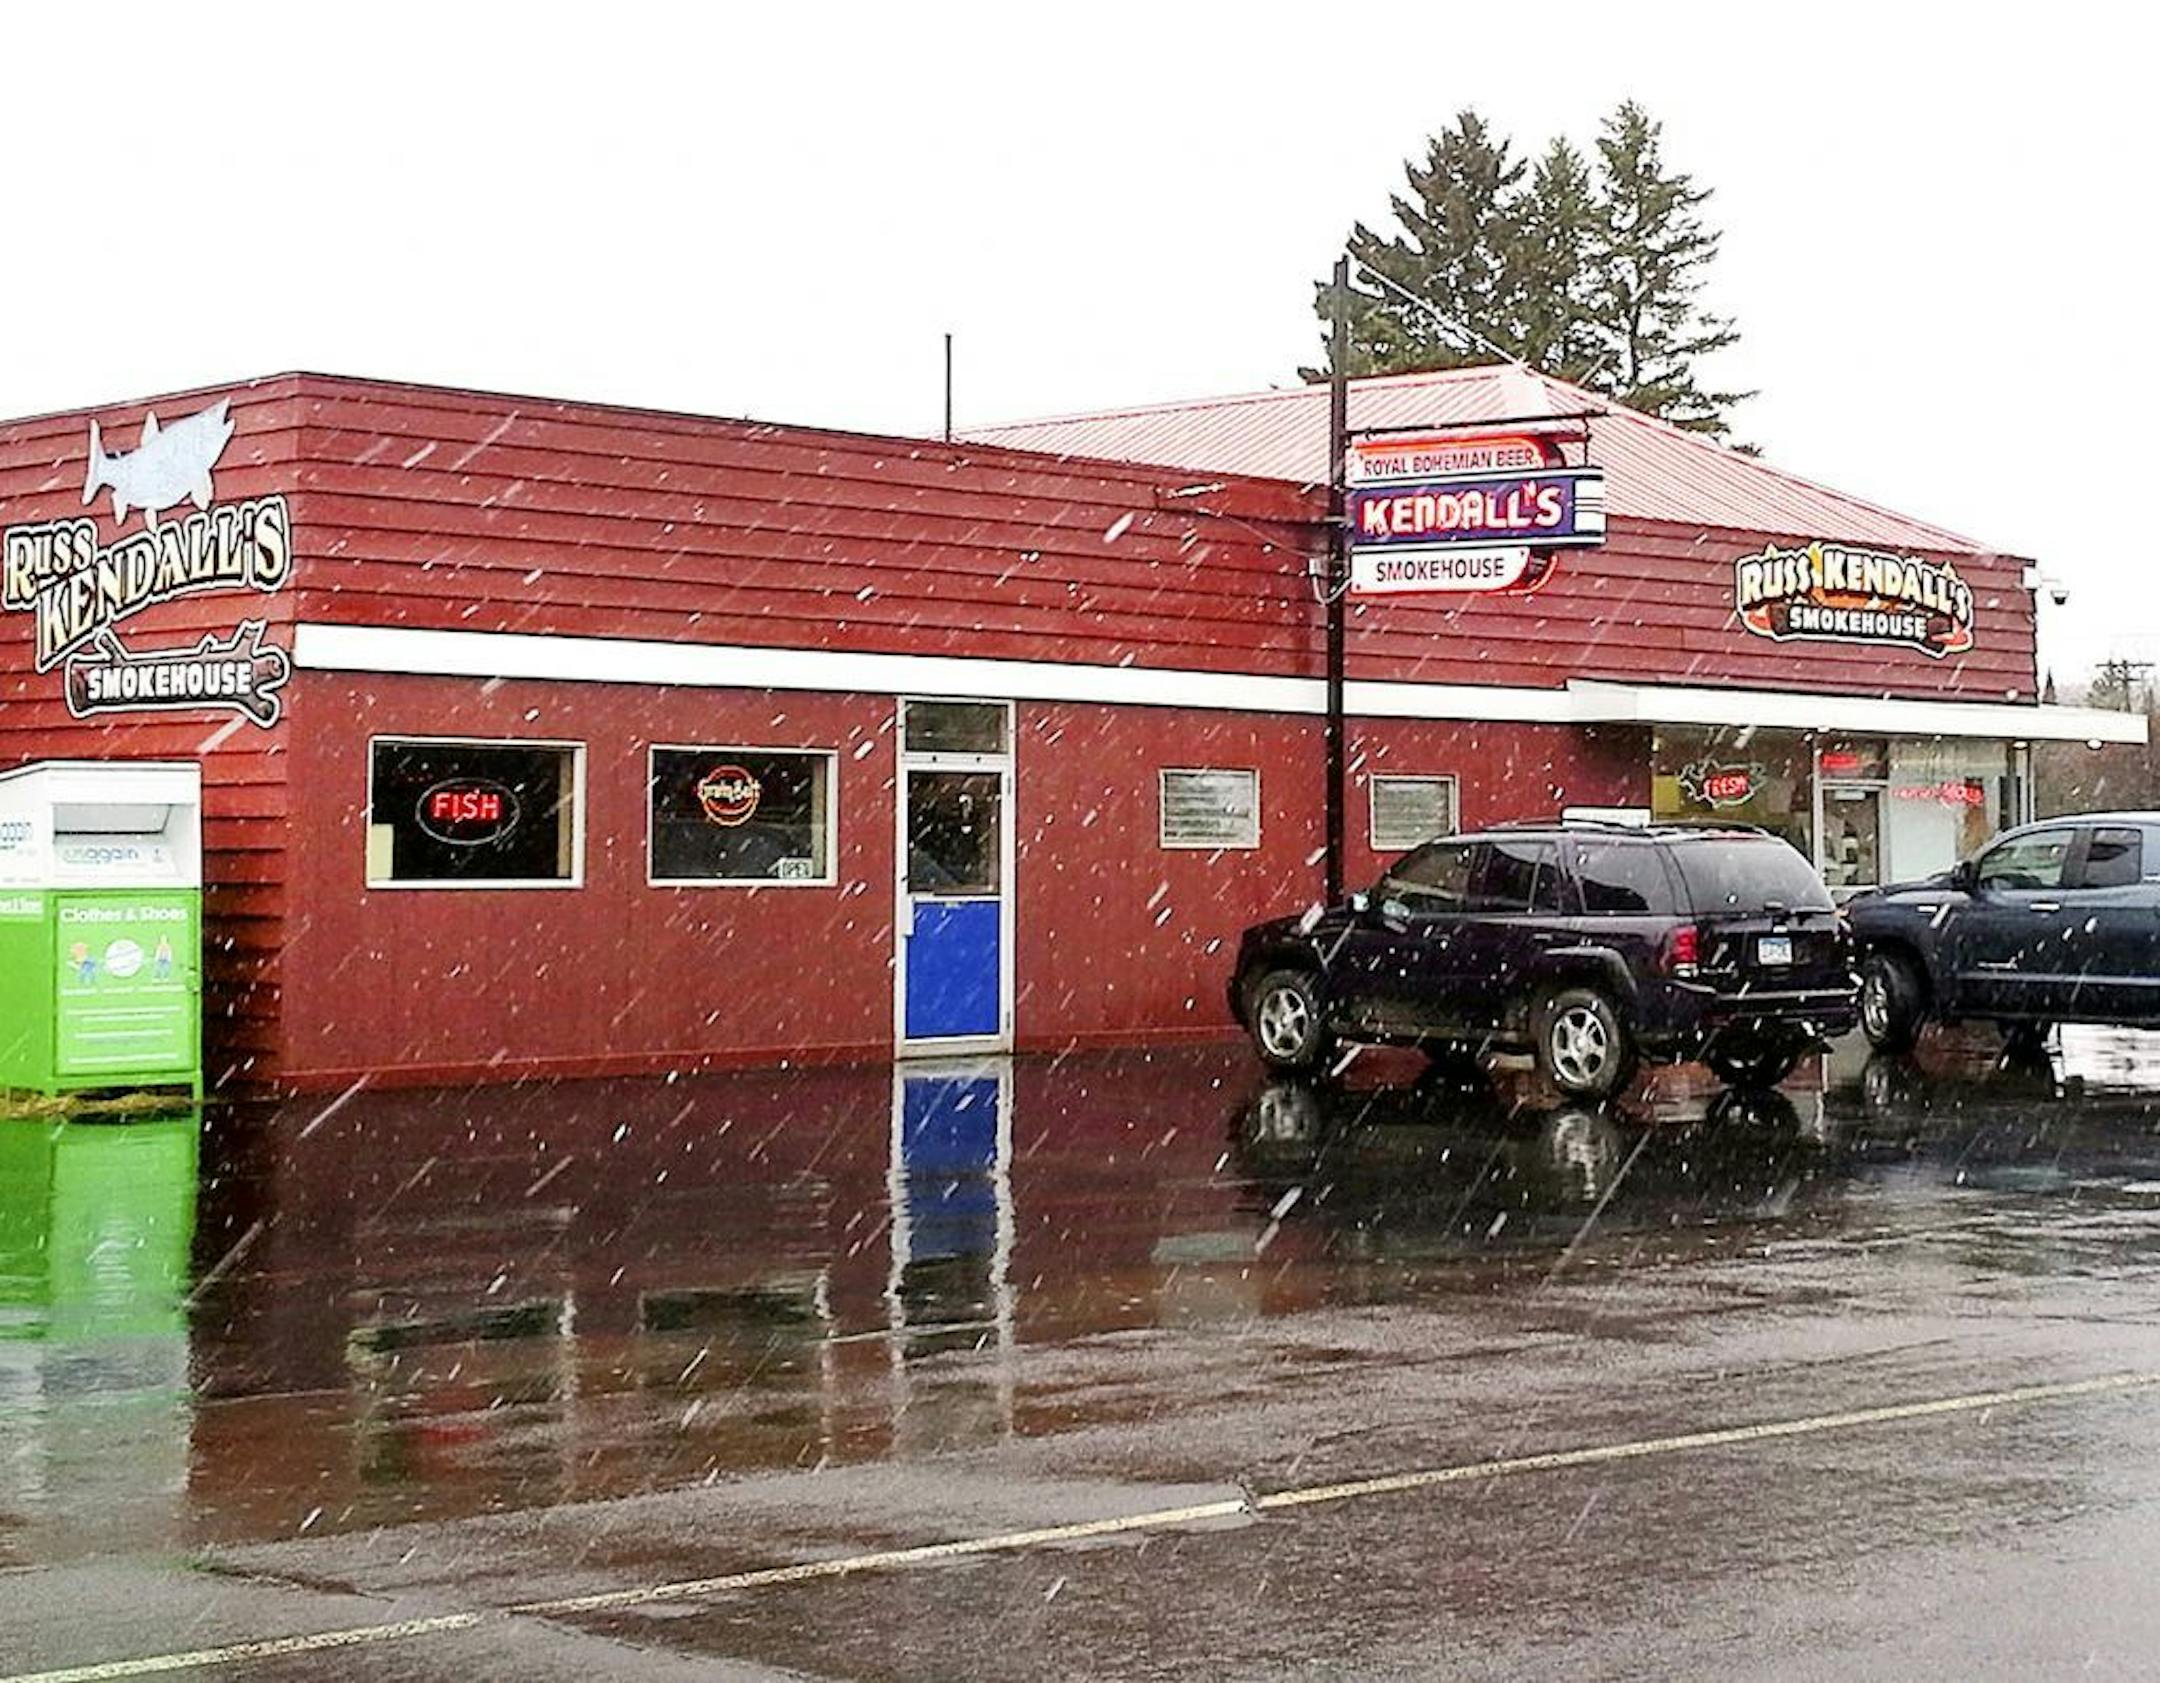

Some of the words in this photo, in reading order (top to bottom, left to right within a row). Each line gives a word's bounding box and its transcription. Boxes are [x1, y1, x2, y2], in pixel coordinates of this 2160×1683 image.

[1364, 457, 1408, 476] ROYAL
[1412, 450, 1492, 473] BOHEMIAN
[1496, 446, 1535, 467] BEER
[1361, 480, 1563, 535] KENDALL'S
[6, 524, 96, 601] RUSS
[1376, 557, 1504, 582] SMOKEHOUSE
[40, 502, 288, 660] KENDALL'S
[1741, 556, 1811, 605] RUSS
[1822, 550, 1969, 622] KENDALL'S
[1789, 607, 1928, 638] SMOKEHOUSE
[86, 662, 252, 700] SMOKEHOUSE
[433, 791, 500, 820] FISH
[60, 907, 122, 923] Clothes
[139, 906, 188, 921] Shoes
